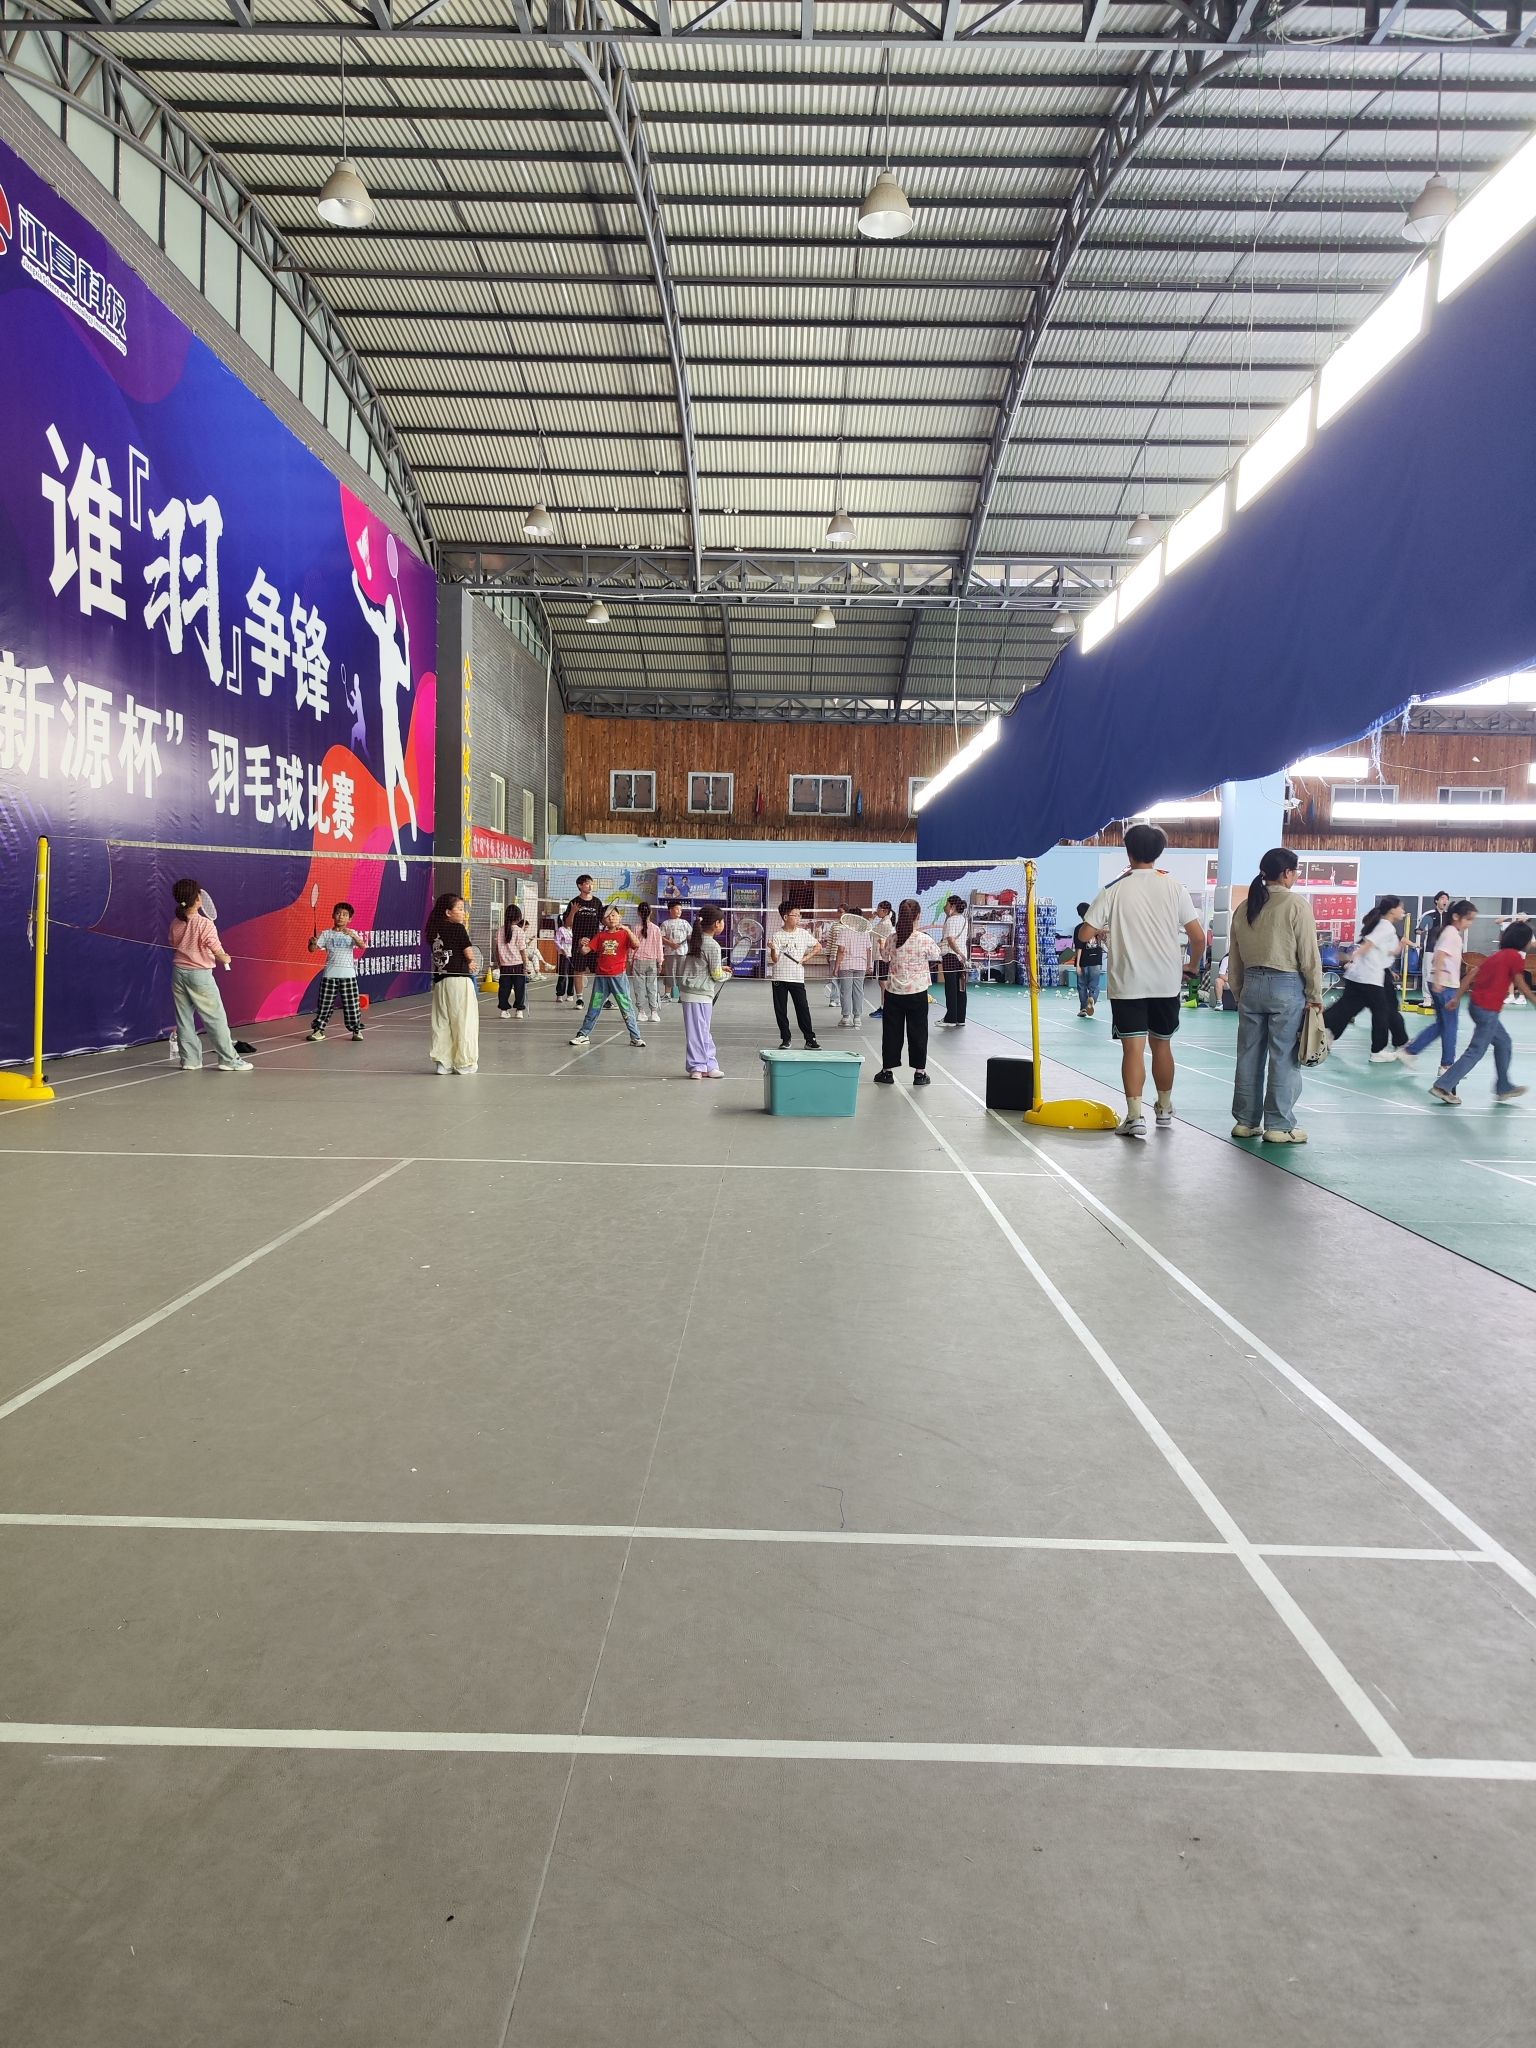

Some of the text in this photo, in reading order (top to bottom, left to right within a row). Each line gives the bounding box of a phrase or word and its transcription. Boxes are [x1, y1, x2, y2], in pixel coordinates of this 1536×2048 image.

[207, 729, 356, 842] 羽毛球比赛
